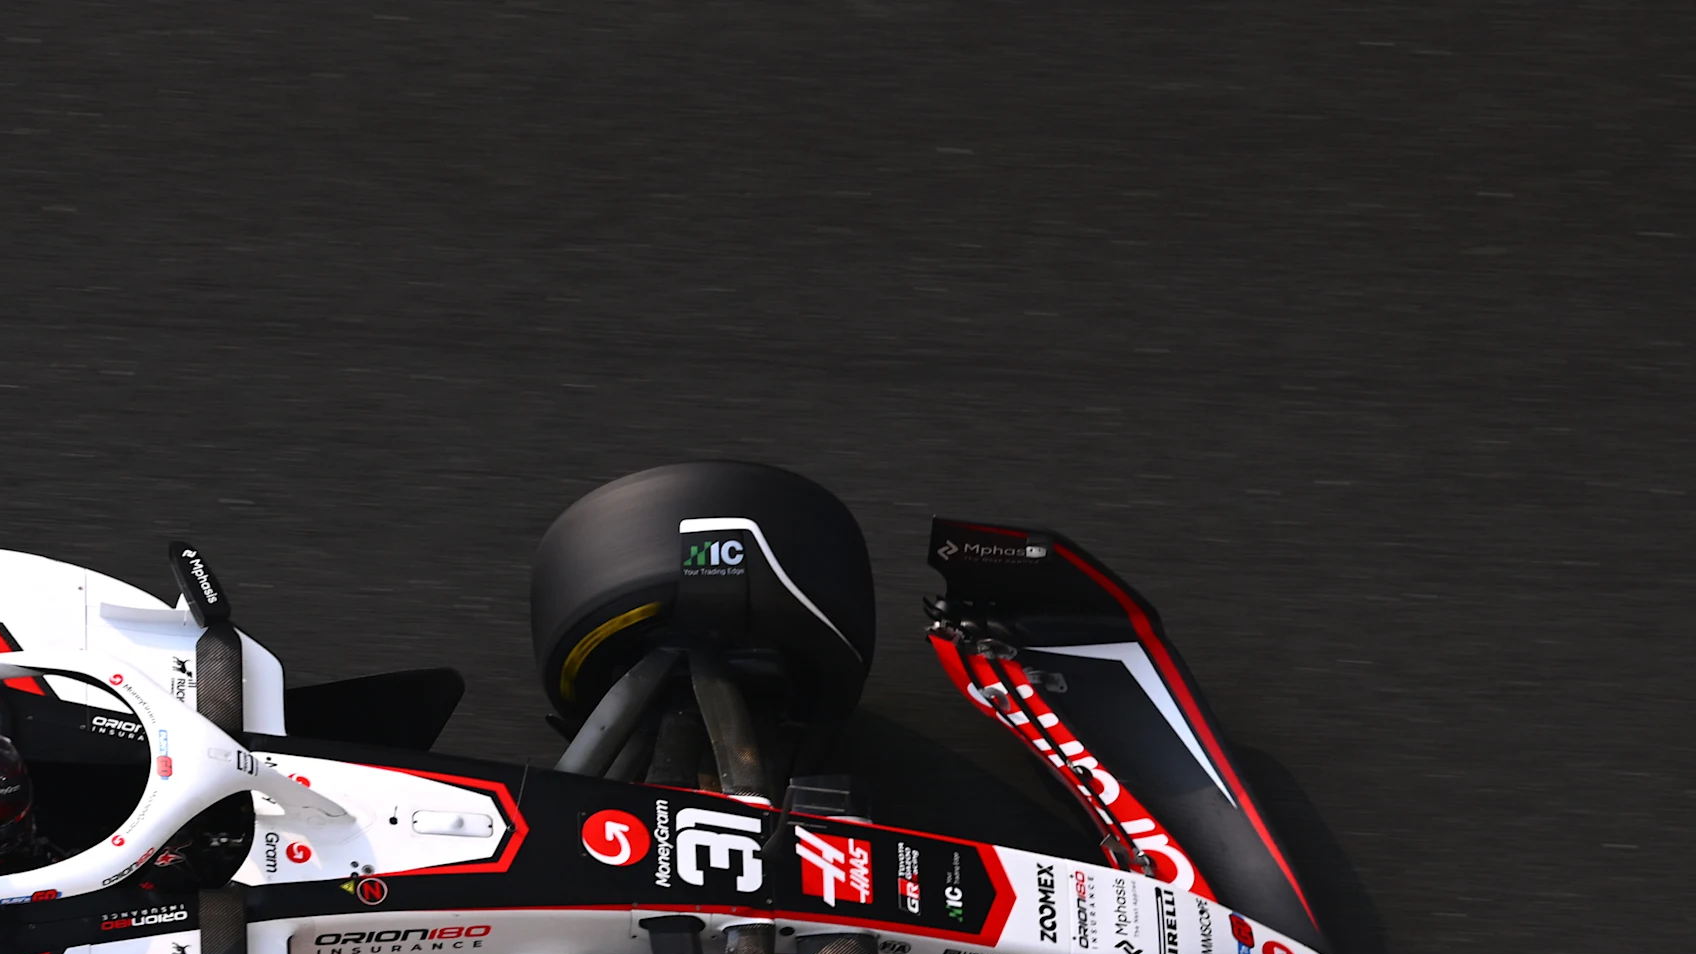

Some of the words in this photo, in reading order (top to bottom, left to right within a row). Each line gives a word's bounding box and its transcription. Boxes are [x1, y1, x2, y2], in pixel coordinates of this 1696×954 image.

[964, 543, 1025, 557] Mphas
[189, 558, 218, 604] Mphasis
[683, 568, 699, 576] Your
[701, 567, 726, 576] Trading
[727, 567, 744, 576] Edge
[176, 679, 185, 703] RUCK
[91, 726, 145, 741] INSURA
[92, 716, 142, 734] ORIO
[654, 799, 674, 888] MoneyGram
[675, 808, 763, 893] 31
[848, 838, 870, 904] HAAS
[362, 881, 382, 901] N
[907, 881, 920, 914] GR
[1036, 862, 1057, 943] ZOOMEX
[102, 904, 185, 921] INSURANCE
[1075, 870, 1089, 949] ORION180
[1087, 876, 1099, 949] INSURANCE
[1112, 878, 1131, 936] Mphasis
[101, 911, 188, 931] ORION180
[314, 925, 492, 946] ORION180
[881, 940, 909, 954] FIA
